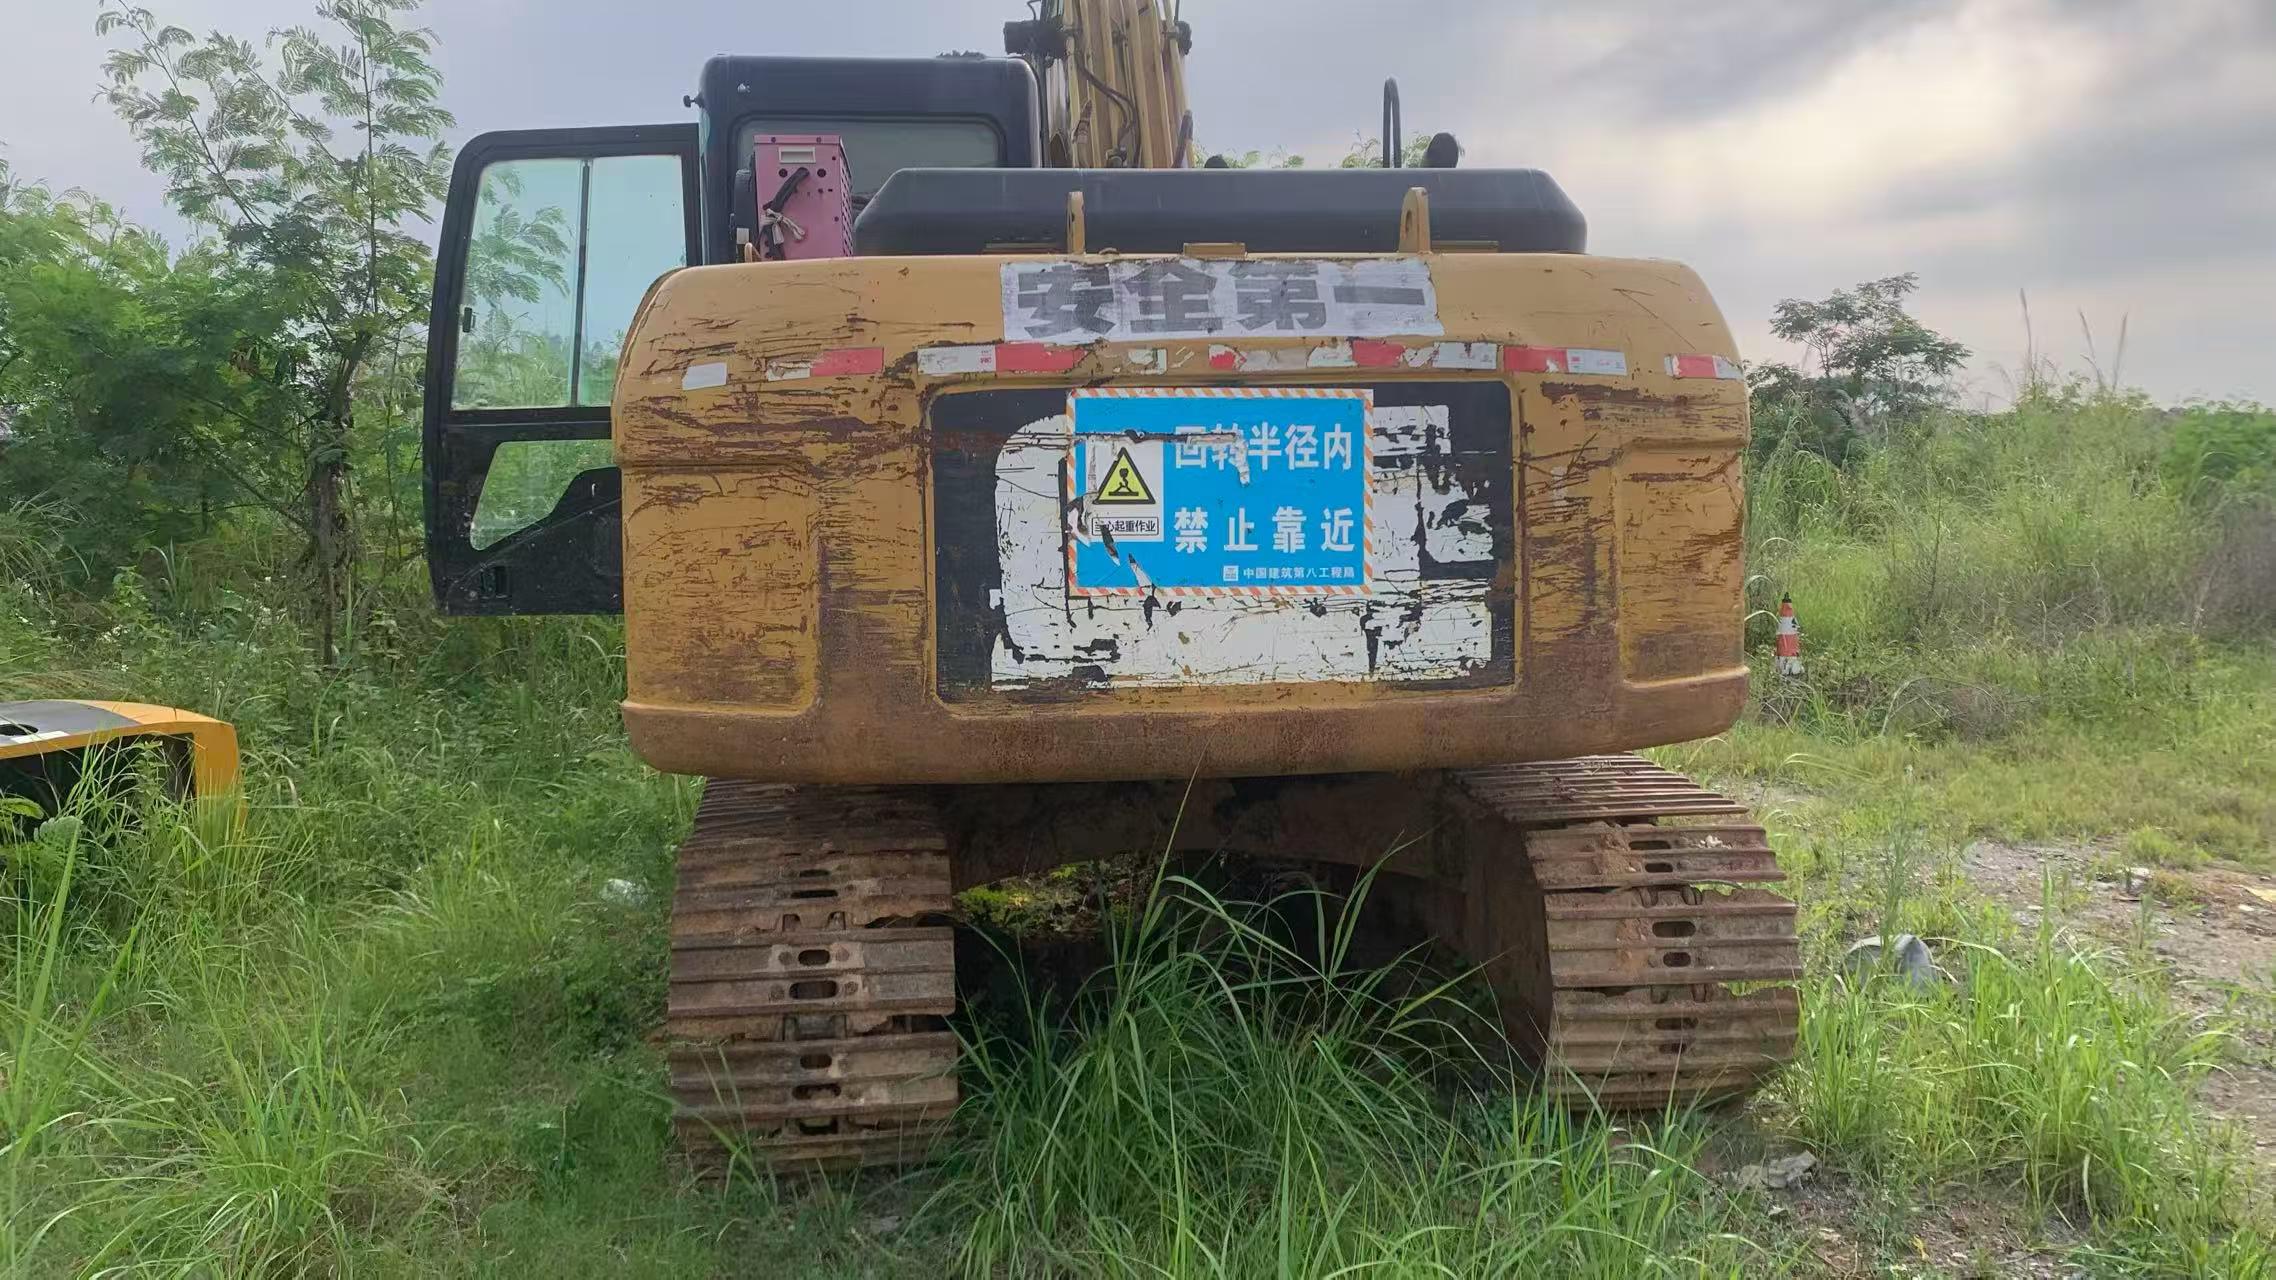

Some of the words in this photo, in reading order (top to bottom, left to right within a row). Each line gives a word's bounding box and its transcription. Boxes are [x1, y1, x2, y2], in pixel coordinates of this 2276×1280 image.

[1018, 264, 1425, 338] 安全第一
[1175, 421, 1352, 471] 回转半径内
[1174, 506, 1355, 553] 禁止靠近
[1243, 566, 1355, 580] 中国建筑第八工程局
